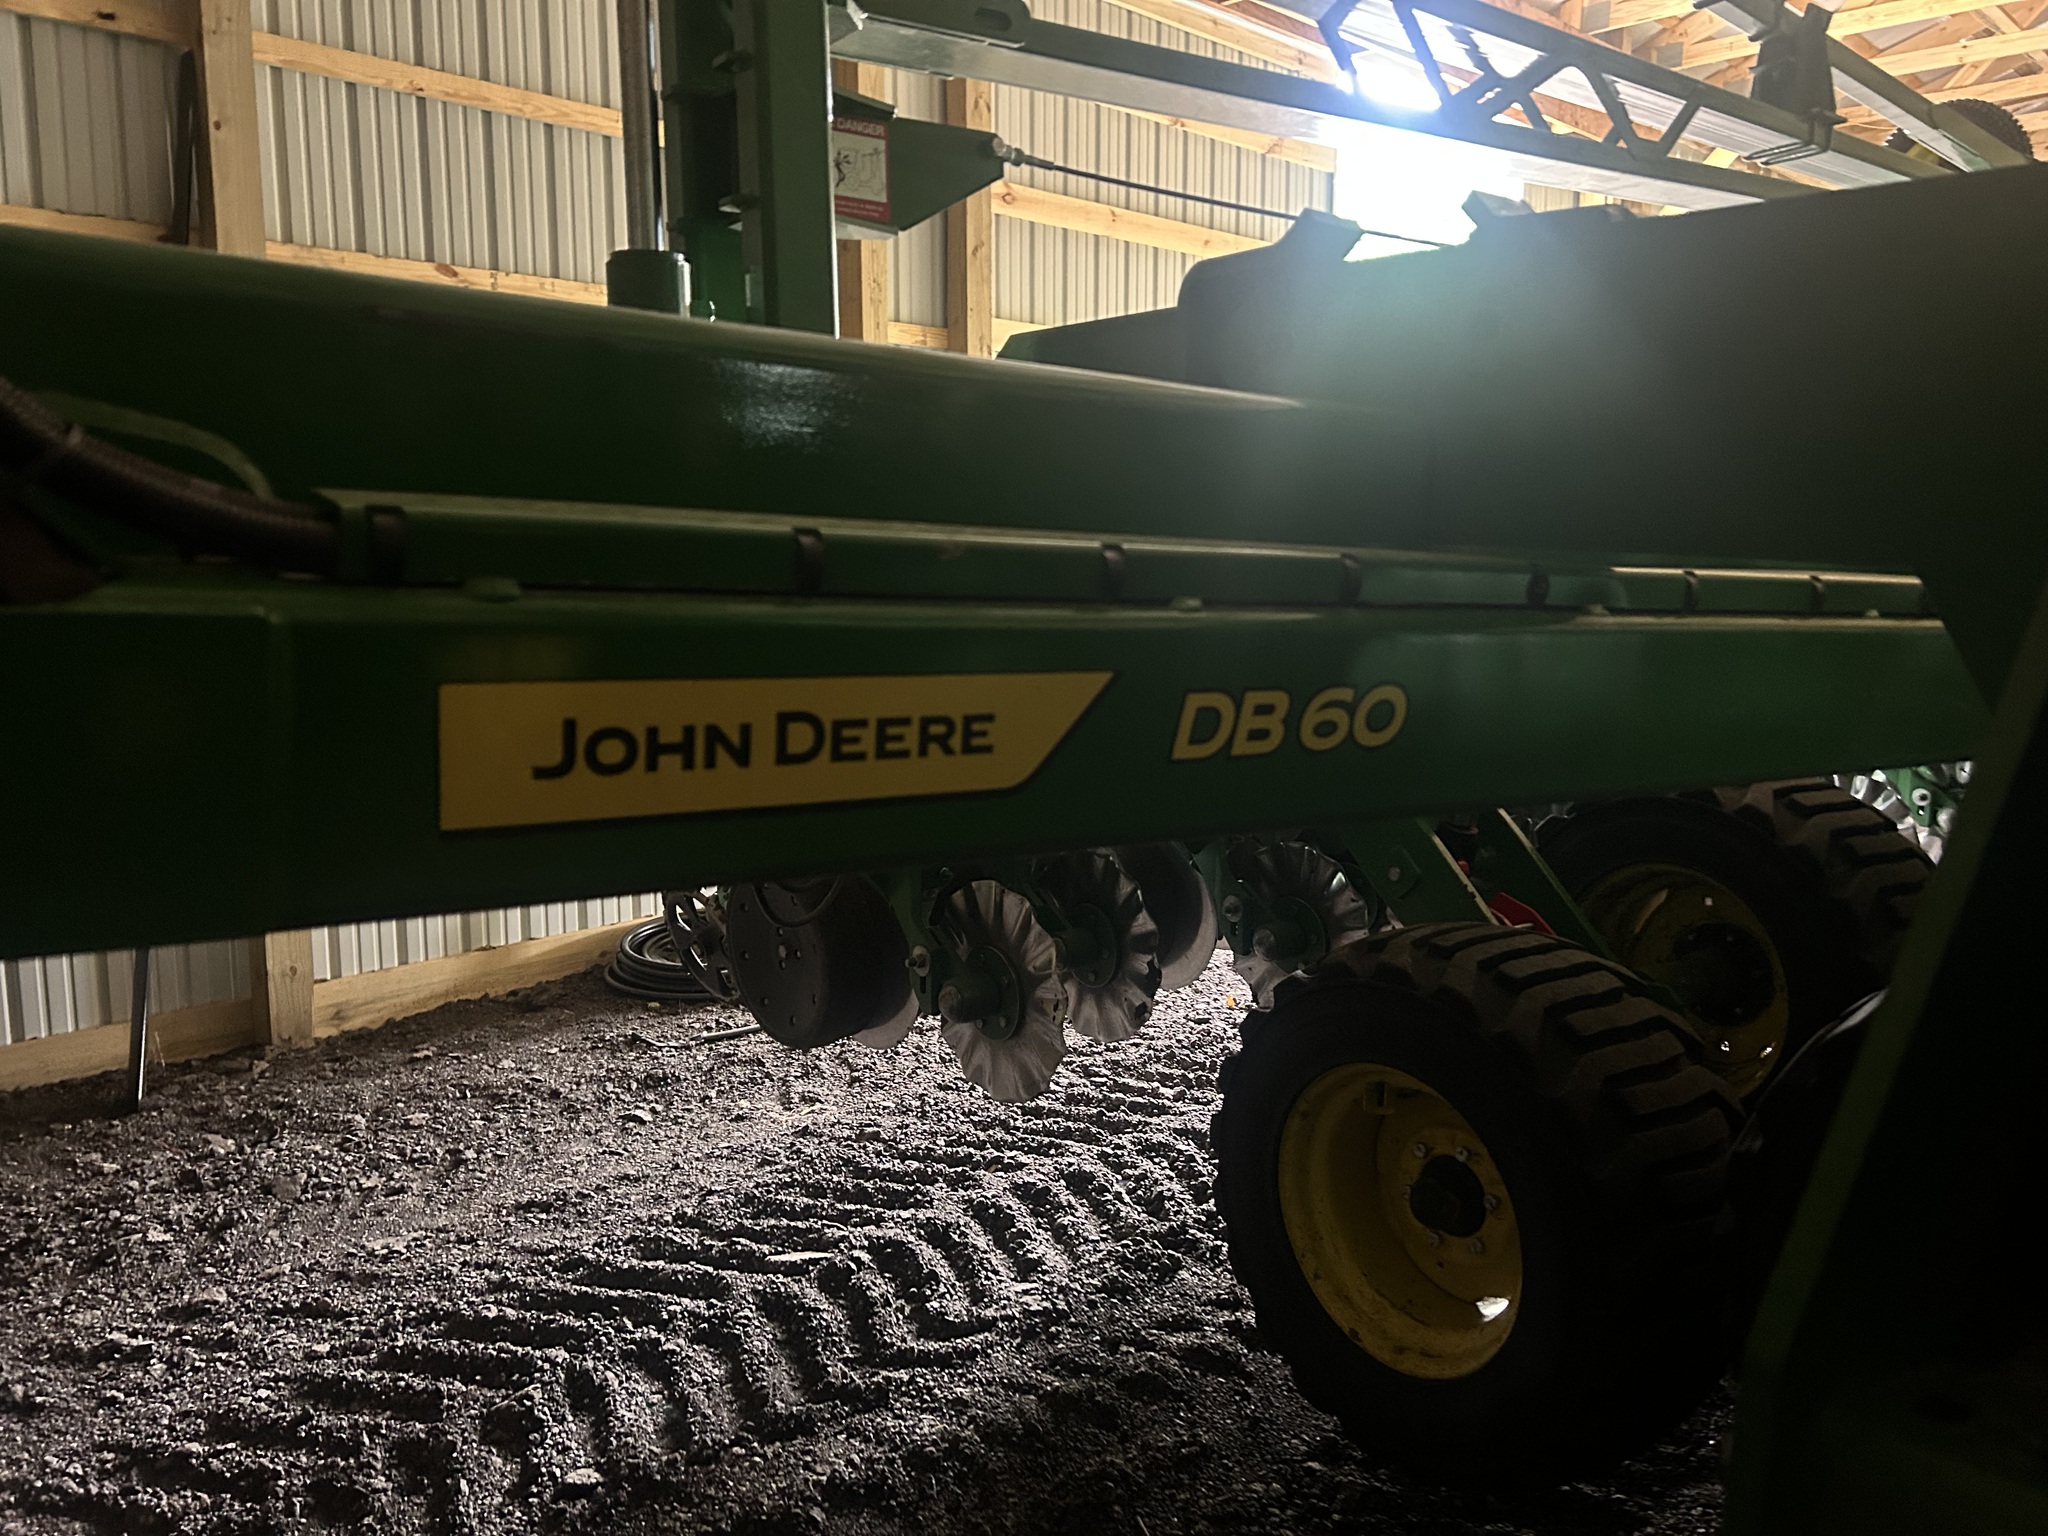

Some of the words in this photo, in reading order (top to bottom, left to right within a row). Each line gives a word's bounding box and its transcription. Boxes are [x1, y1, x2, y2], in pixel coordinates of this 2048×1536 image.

[837, 117, 885, 137] DANGER
[532, 718, 752, 780] JOHN
[774, 711, 995, 766] DEERE
[1171, 690, 1290, 760] DB
[1300, 684, 1407, 751] 60
